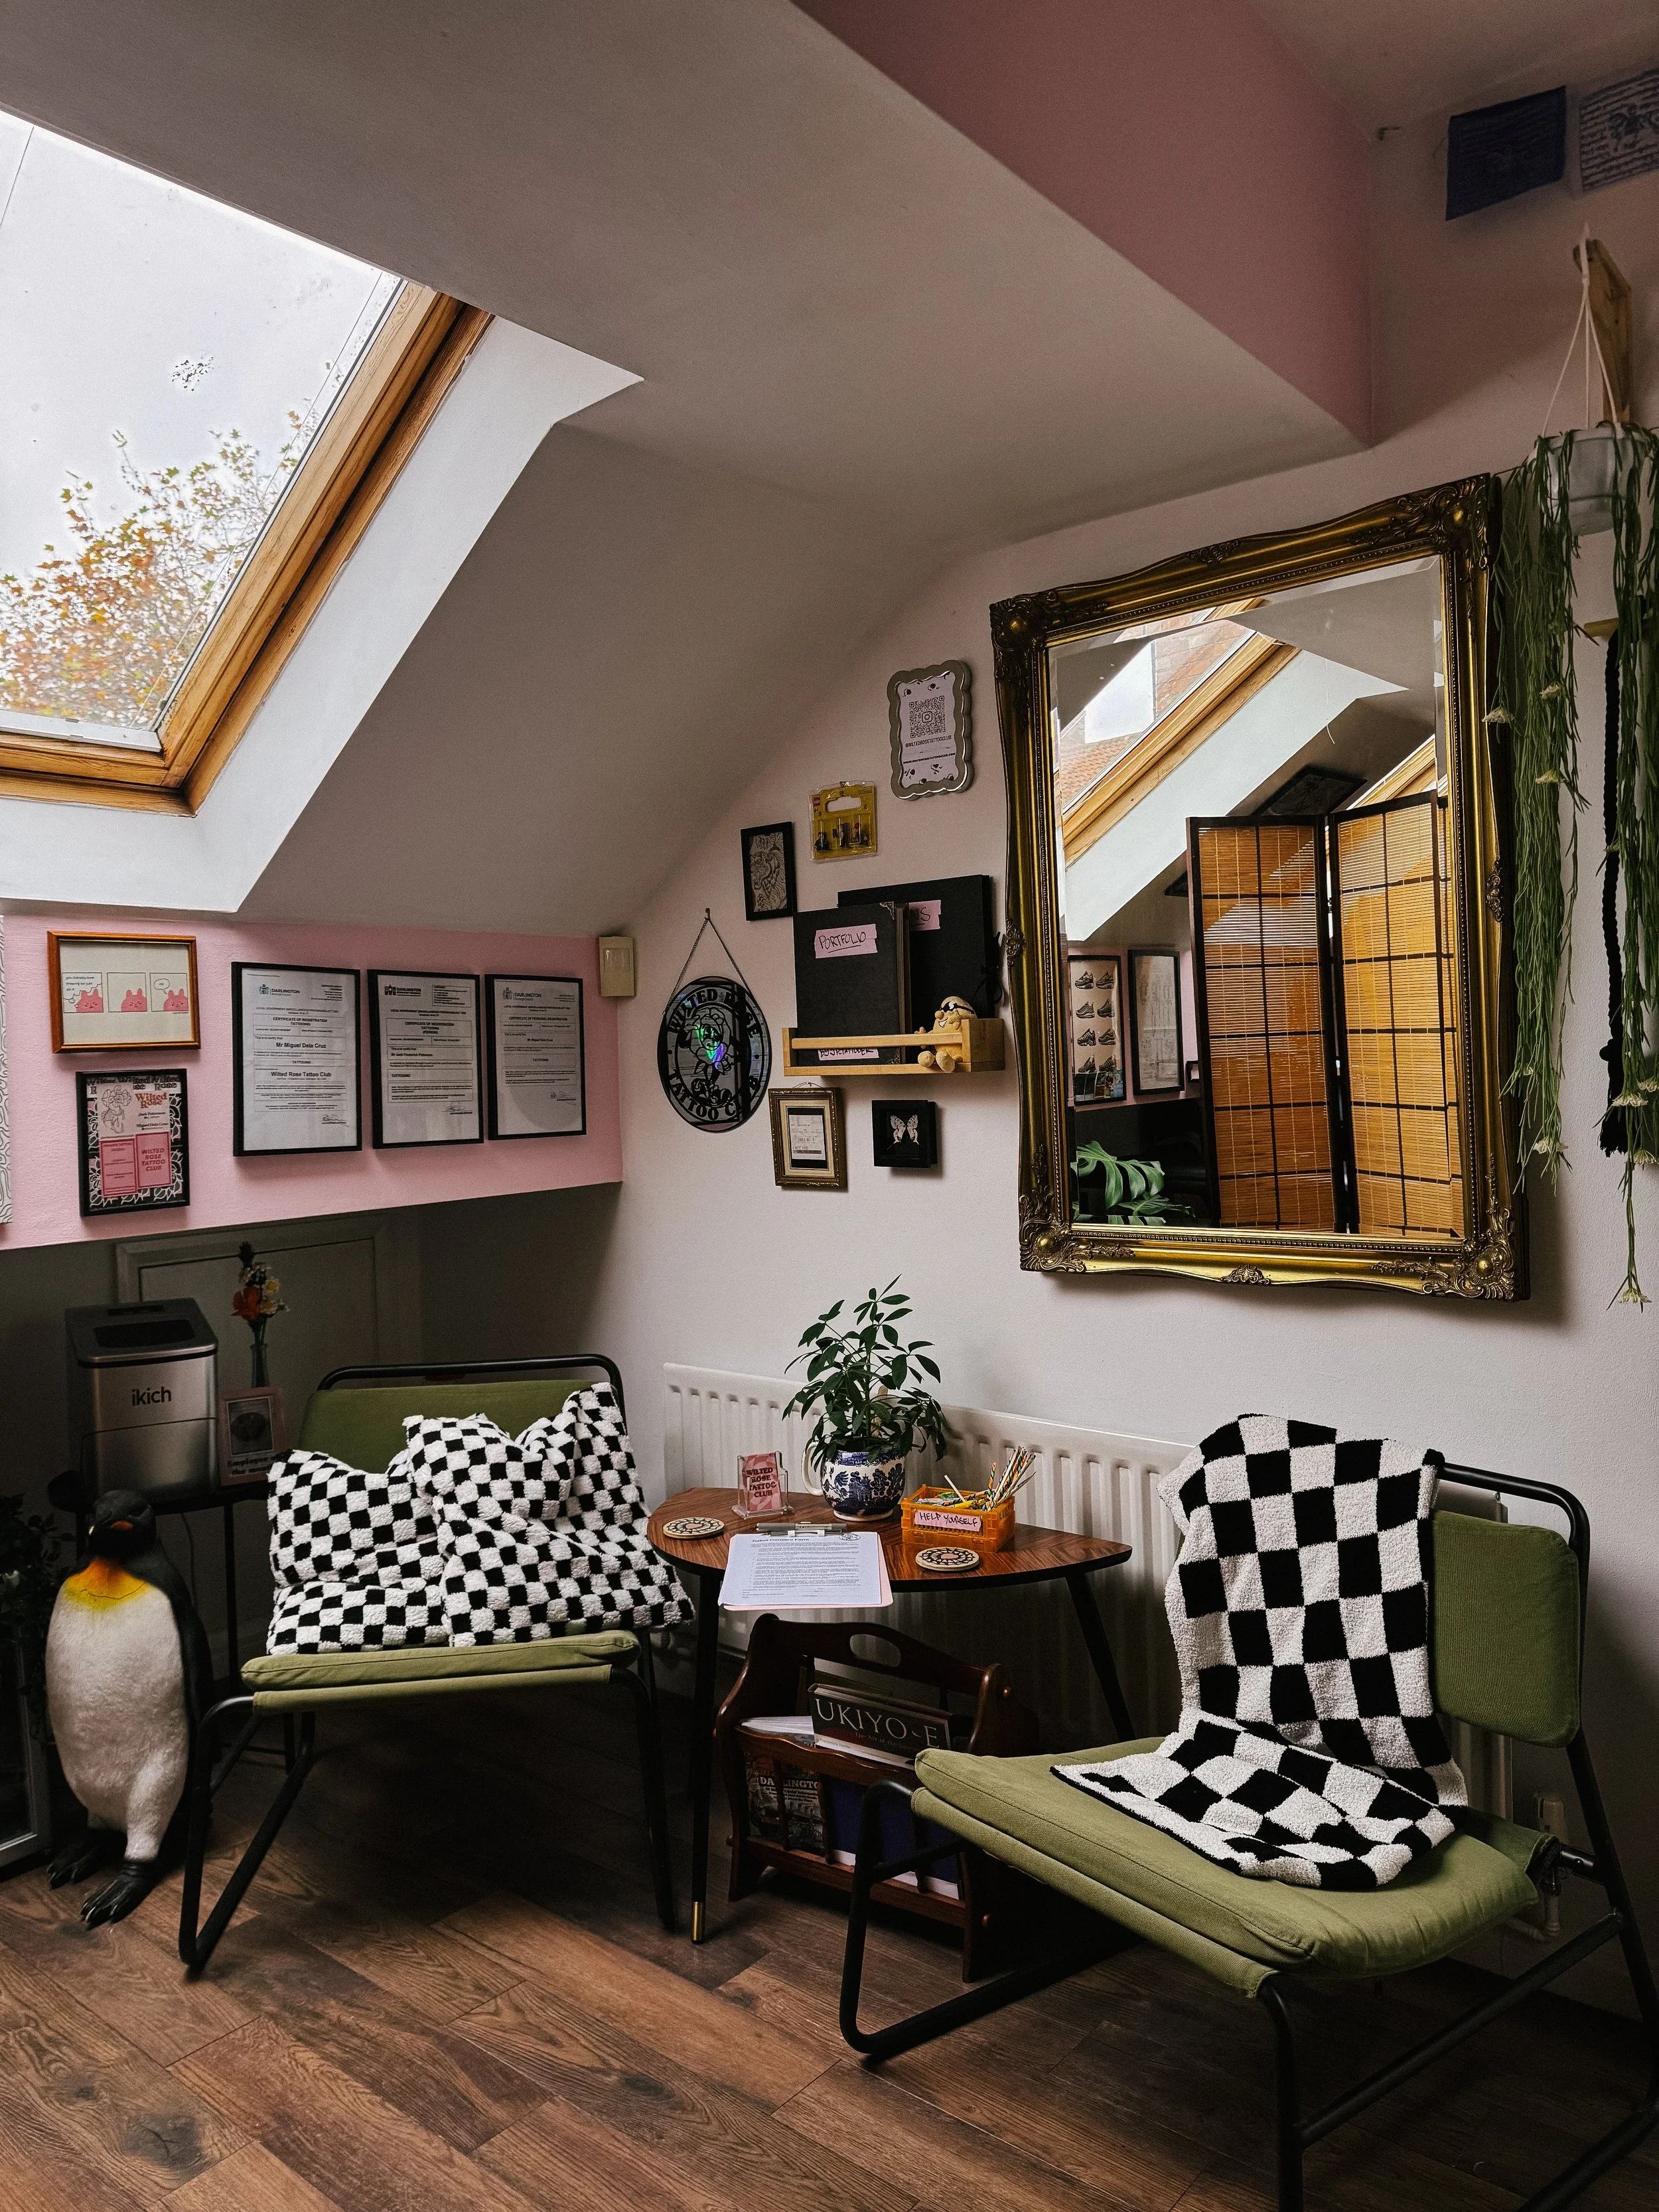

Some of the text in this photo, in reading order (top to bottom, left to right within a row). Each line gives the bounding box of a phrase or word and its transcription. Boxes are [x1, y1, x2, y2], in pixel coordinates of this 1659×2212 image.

[818, 931, 867, 950] PORTFOLIO
[135, 1092, 169, 1102] Wilted
[668, 1069, 719, 1120] TATTOO
[141, 1100, 163, 1109] Rose
[132, 1386, 171, 1406] ikich
[749, 1481, 776, 1491] TATTOO
[920, 1512, 977, 1527] HELP YOURSELF
[815, 1698, 940, 1748] UKIYO-E
